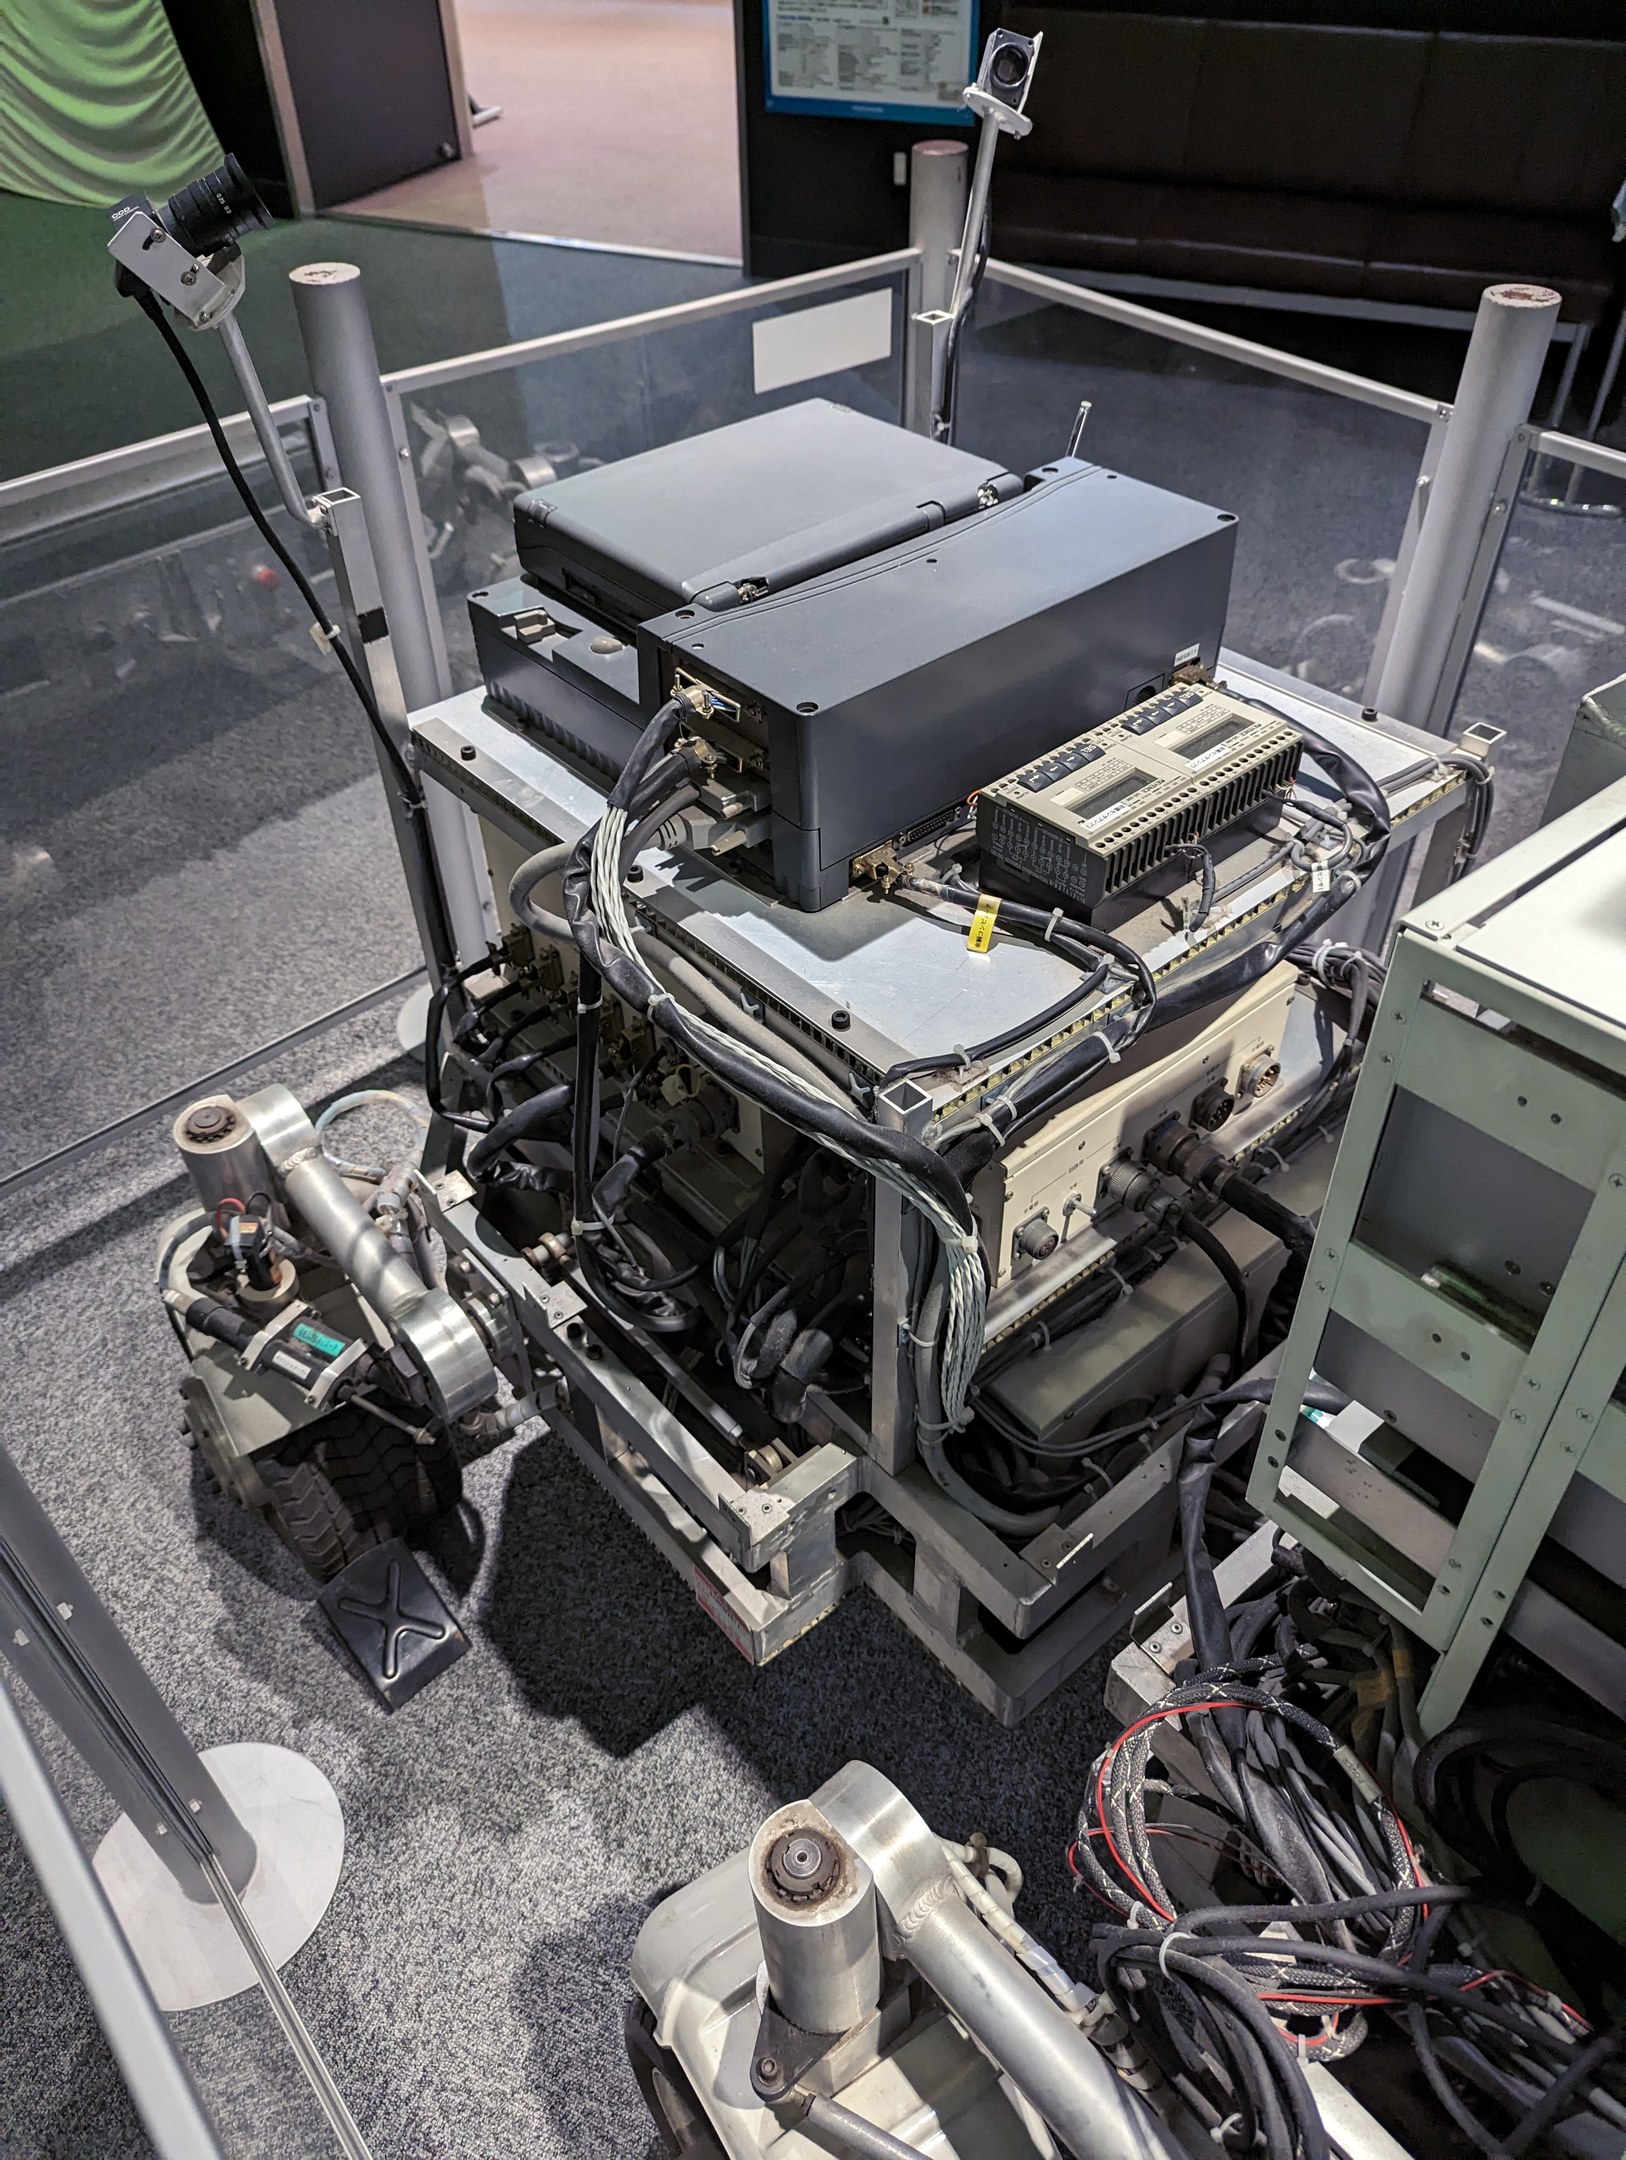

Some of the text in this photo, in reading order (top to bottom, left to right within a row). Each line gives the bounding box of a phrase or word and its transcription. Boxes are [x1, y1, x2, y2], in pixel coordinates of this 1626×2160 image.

[111, 206, 130, 219] CCD
[1239, 723, 1263, 737] KEYENCE
[1080, 744, 1097, 754] SEL
[1140, 778, 1166, 795] KEYENCE
